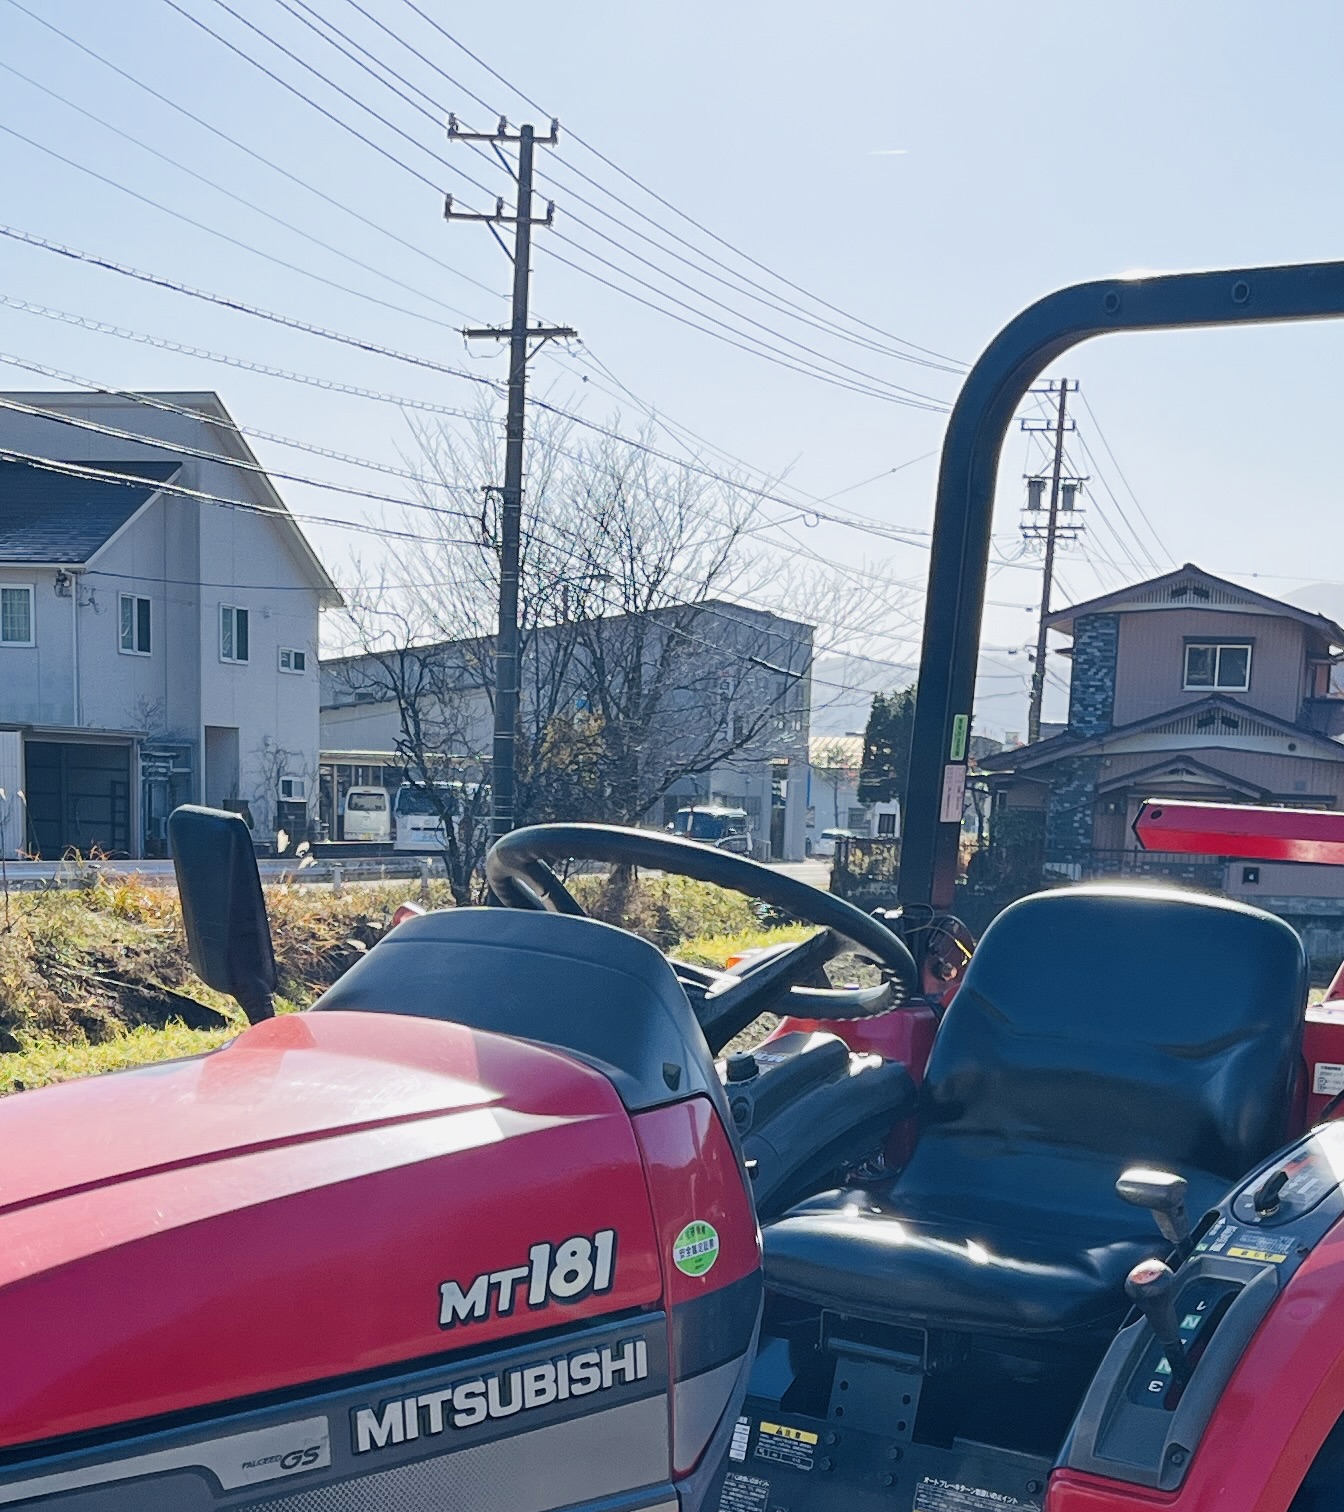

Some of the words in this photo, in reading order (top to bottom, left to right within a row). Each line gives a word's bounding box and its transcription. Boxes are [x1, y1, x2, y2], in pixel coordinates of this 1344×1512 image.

[439, 1229, 616, 1326] MT181
[1181, 1314, 1201, 1330] N
[356, 1339, 649, 1453] MITSUBISHI
[1148, 1380, 1164, 1393] 3
[280, 1445, 321, 1470] GS
